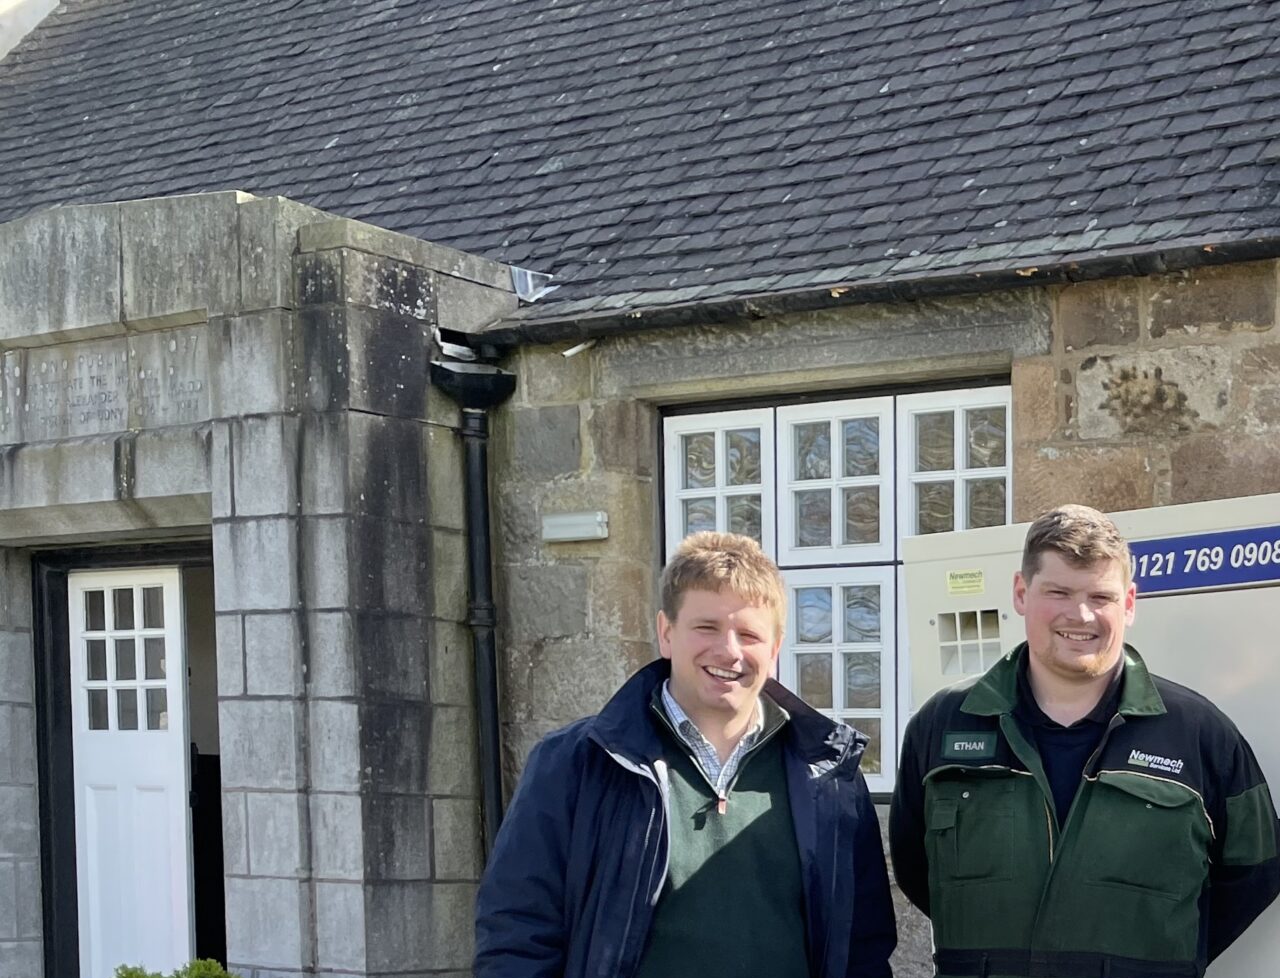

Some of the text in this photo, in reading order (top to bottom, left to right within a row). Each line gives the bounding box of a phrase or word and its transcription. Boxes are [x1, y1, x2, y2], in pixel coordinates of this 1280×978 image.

[1131, 551, 1175, 580] 121
[1183, 546, 1224, 573] 769
[953, 741, 985, 751] ETHAN
